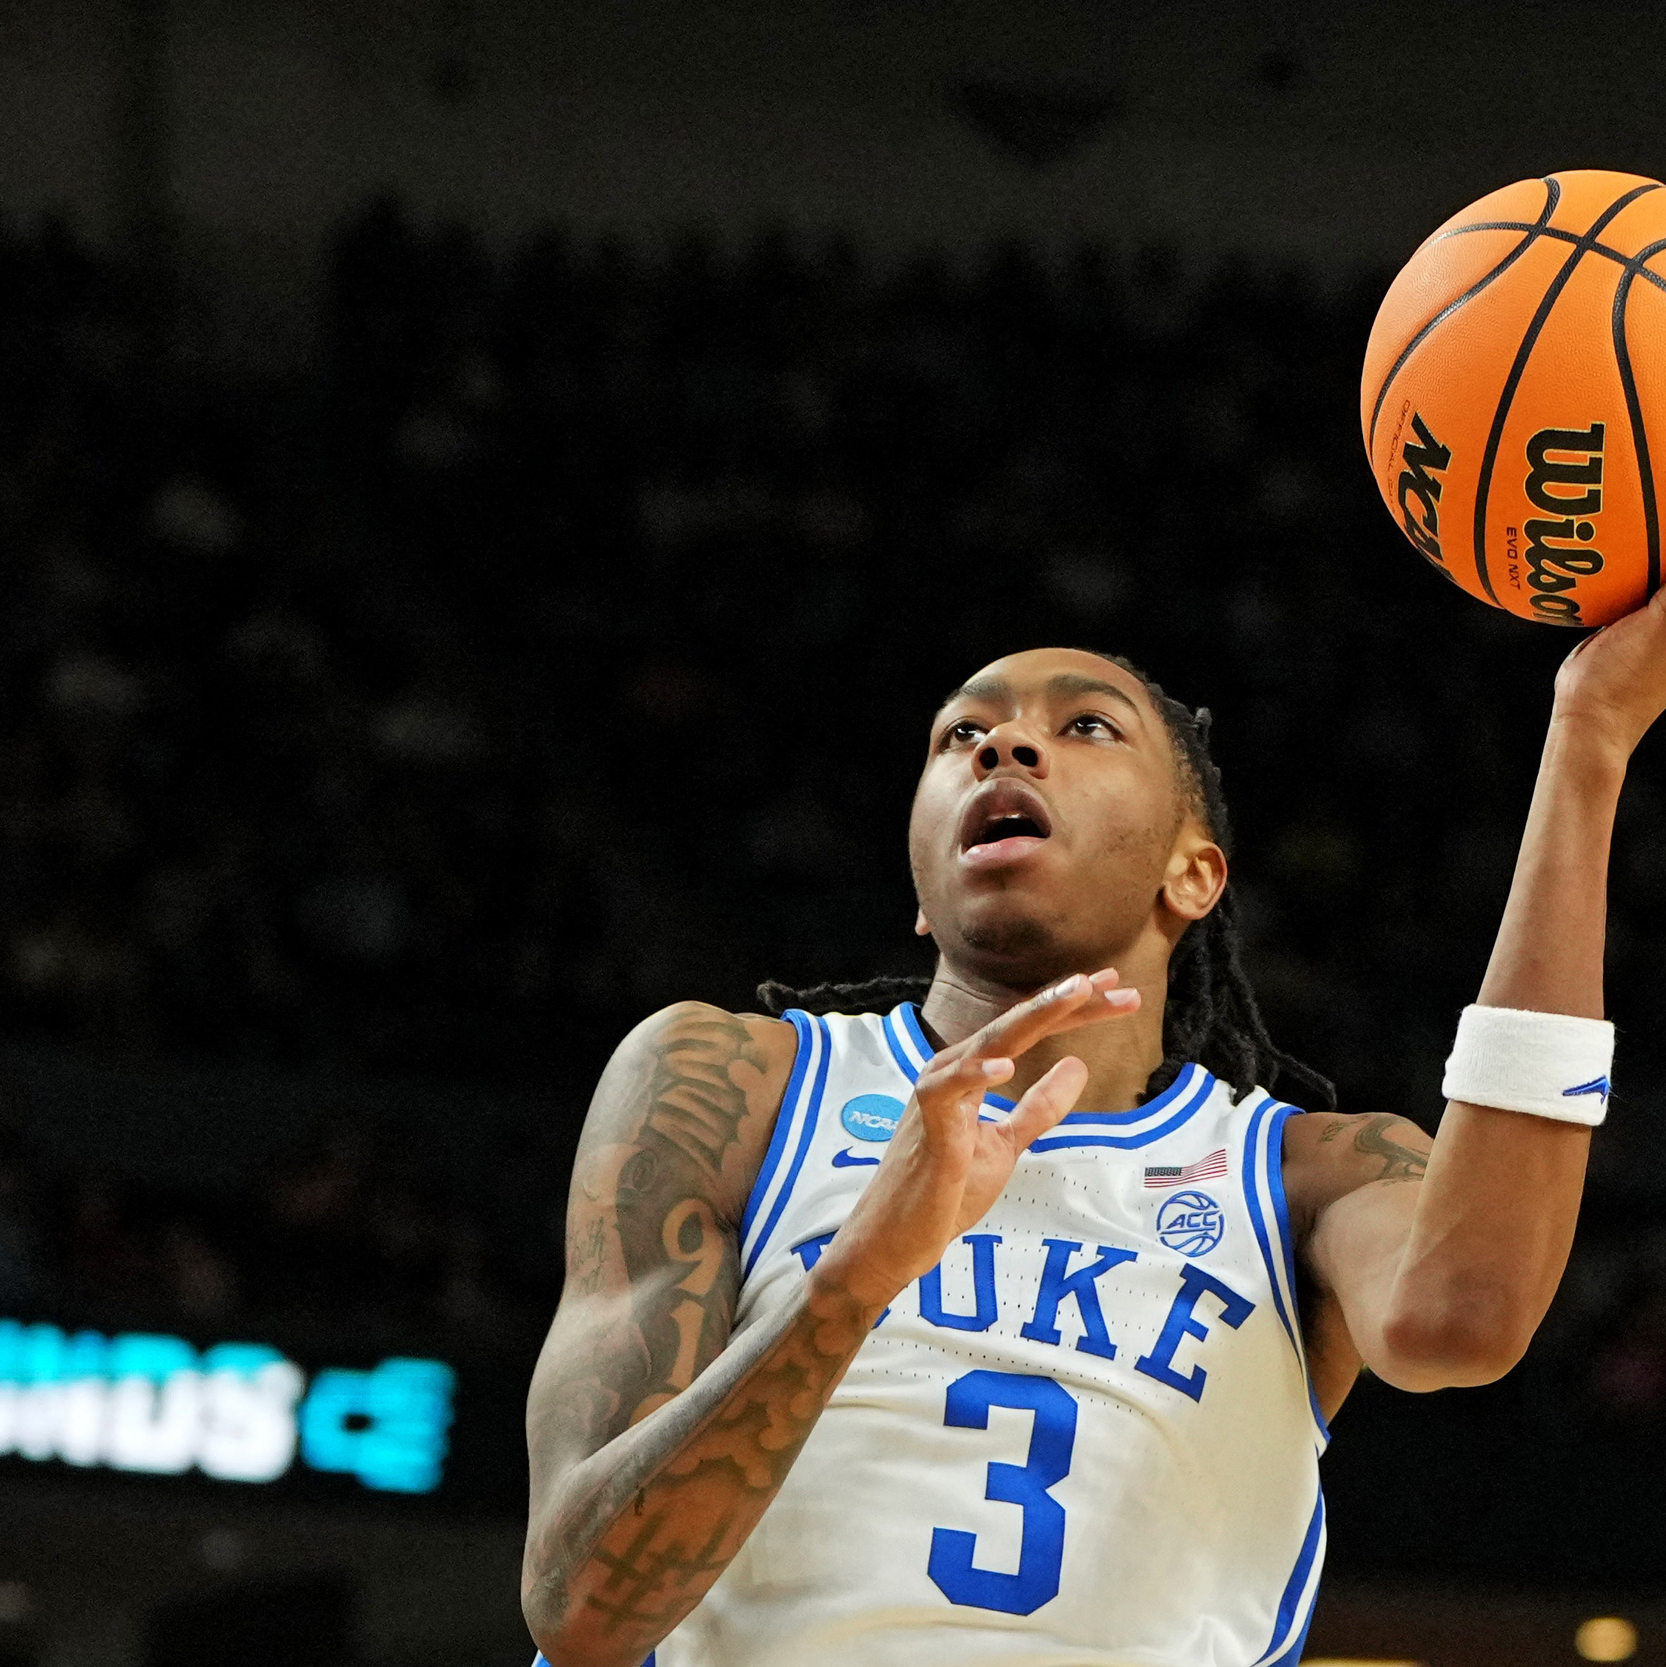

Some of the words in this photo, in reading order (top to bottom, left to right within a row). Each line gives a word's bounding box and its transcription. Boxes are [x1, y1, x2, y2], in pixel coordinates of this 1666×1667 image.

[1397, 411, 1454, 583] NCA
[1506, 526, 1518, 560] EVO
[1508, 563, 1521, 591] NXT
[1166, 1210, 1220, 1228] ACC
[928, 1370, 1078, 1616] 3
